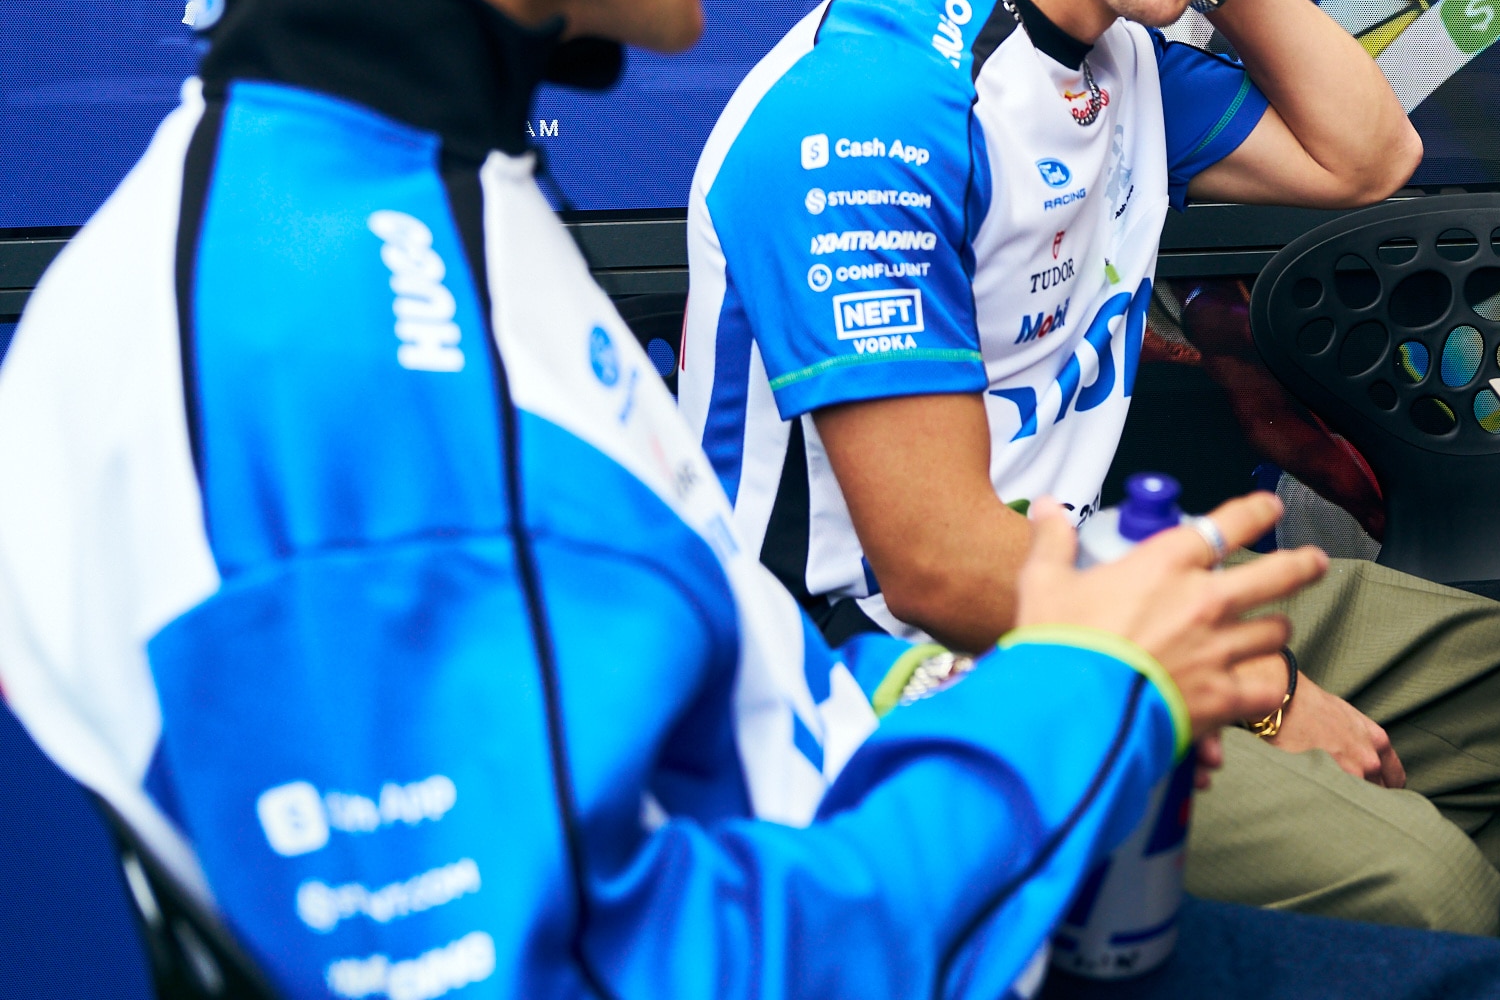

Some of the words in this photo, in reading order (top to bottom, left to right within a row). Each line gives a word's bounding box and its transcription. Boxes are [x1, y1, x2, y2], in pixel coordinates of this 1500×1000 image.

[835, 137, 886, 158] Cash
[888, 139, 930, 167] App
[827, 189, 932, 209] STUDENT.COM
[1043, 187, 1087, 212] RACING
[1030, 258, 1075, 294] TUDOR
[843, 299, 912, 329] NEFT
[853, 334, 917, 355] VODKA
